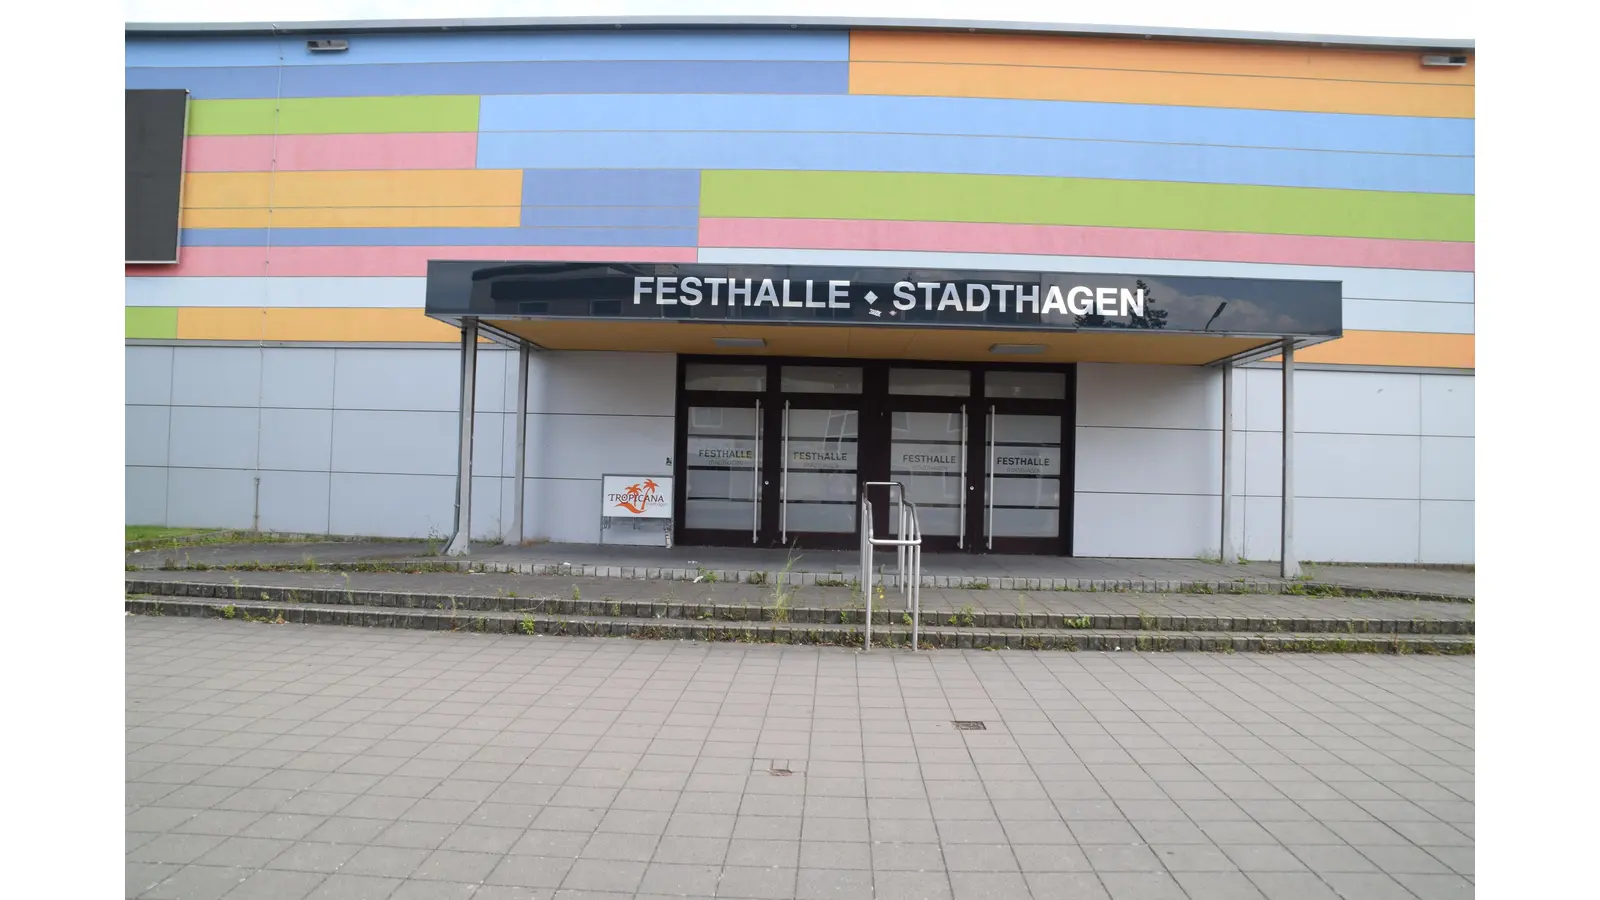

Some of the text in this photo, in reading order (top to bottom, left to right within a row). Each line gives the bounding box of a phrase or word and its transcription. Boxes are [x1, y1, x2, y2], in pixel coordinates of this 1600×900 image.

[633, 276, 1145, 317] FESTHALLE STADTHAGEN
[698, 449, 753, 459] FESTHALLE
[793, 451, 848, 461] FESTHALLE
[903, 454, 957, 464] FESTHALLE
[996, 456, 1050, 466] FESTHALLE
[608, 493, 665, 503] TROPICANA
